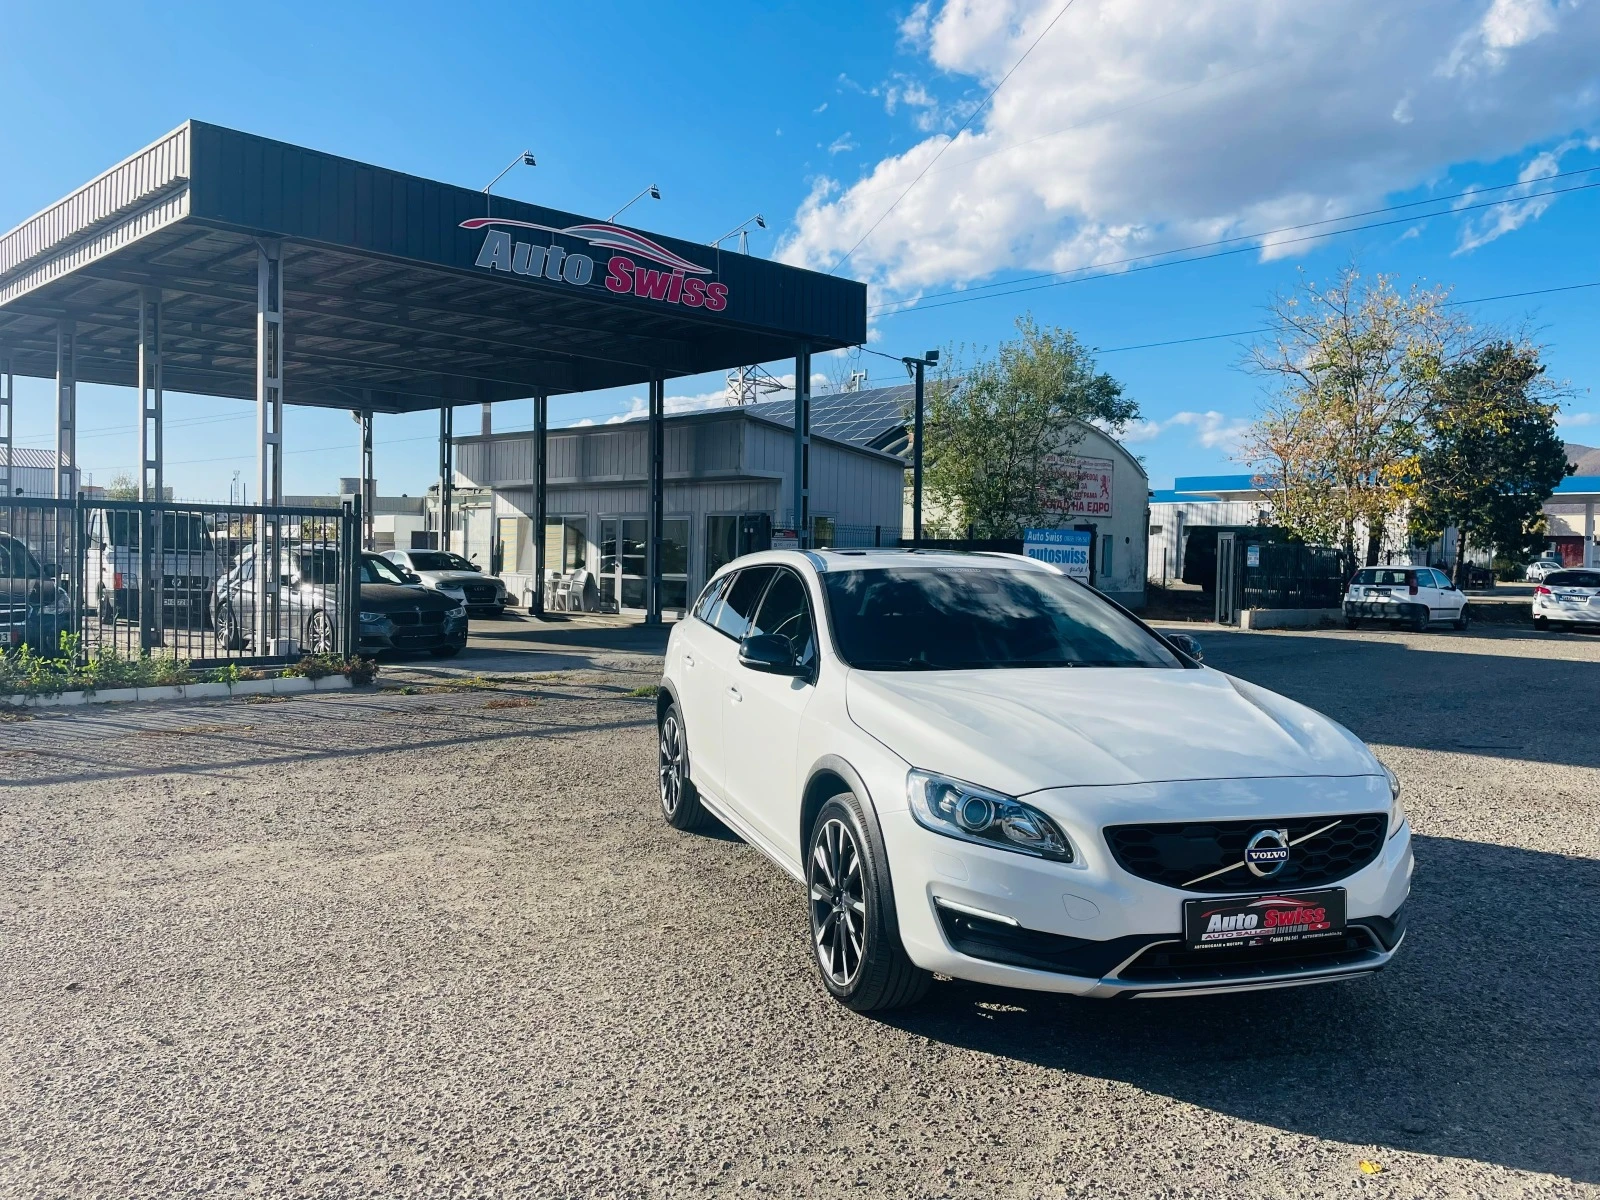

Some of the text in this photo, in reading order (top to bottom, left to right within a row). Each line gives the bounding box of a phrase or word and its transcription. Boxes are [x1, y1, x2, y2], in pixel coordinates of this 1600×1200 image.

[475, 229, 728, 312] Auto Swiss
[1073, 501, 1084, 511] НА
[1087, 502, 1109, 514] ЕДРО
[1027, 531, 1044, 541] Auto
[1045, 531, 1063, 542] Swiss
[1250, 850, 1287, 860] VOLVO
[1206, 906, 1326, 933] Auto Swiss
[1205, 932, 1234, 940] AUTO
